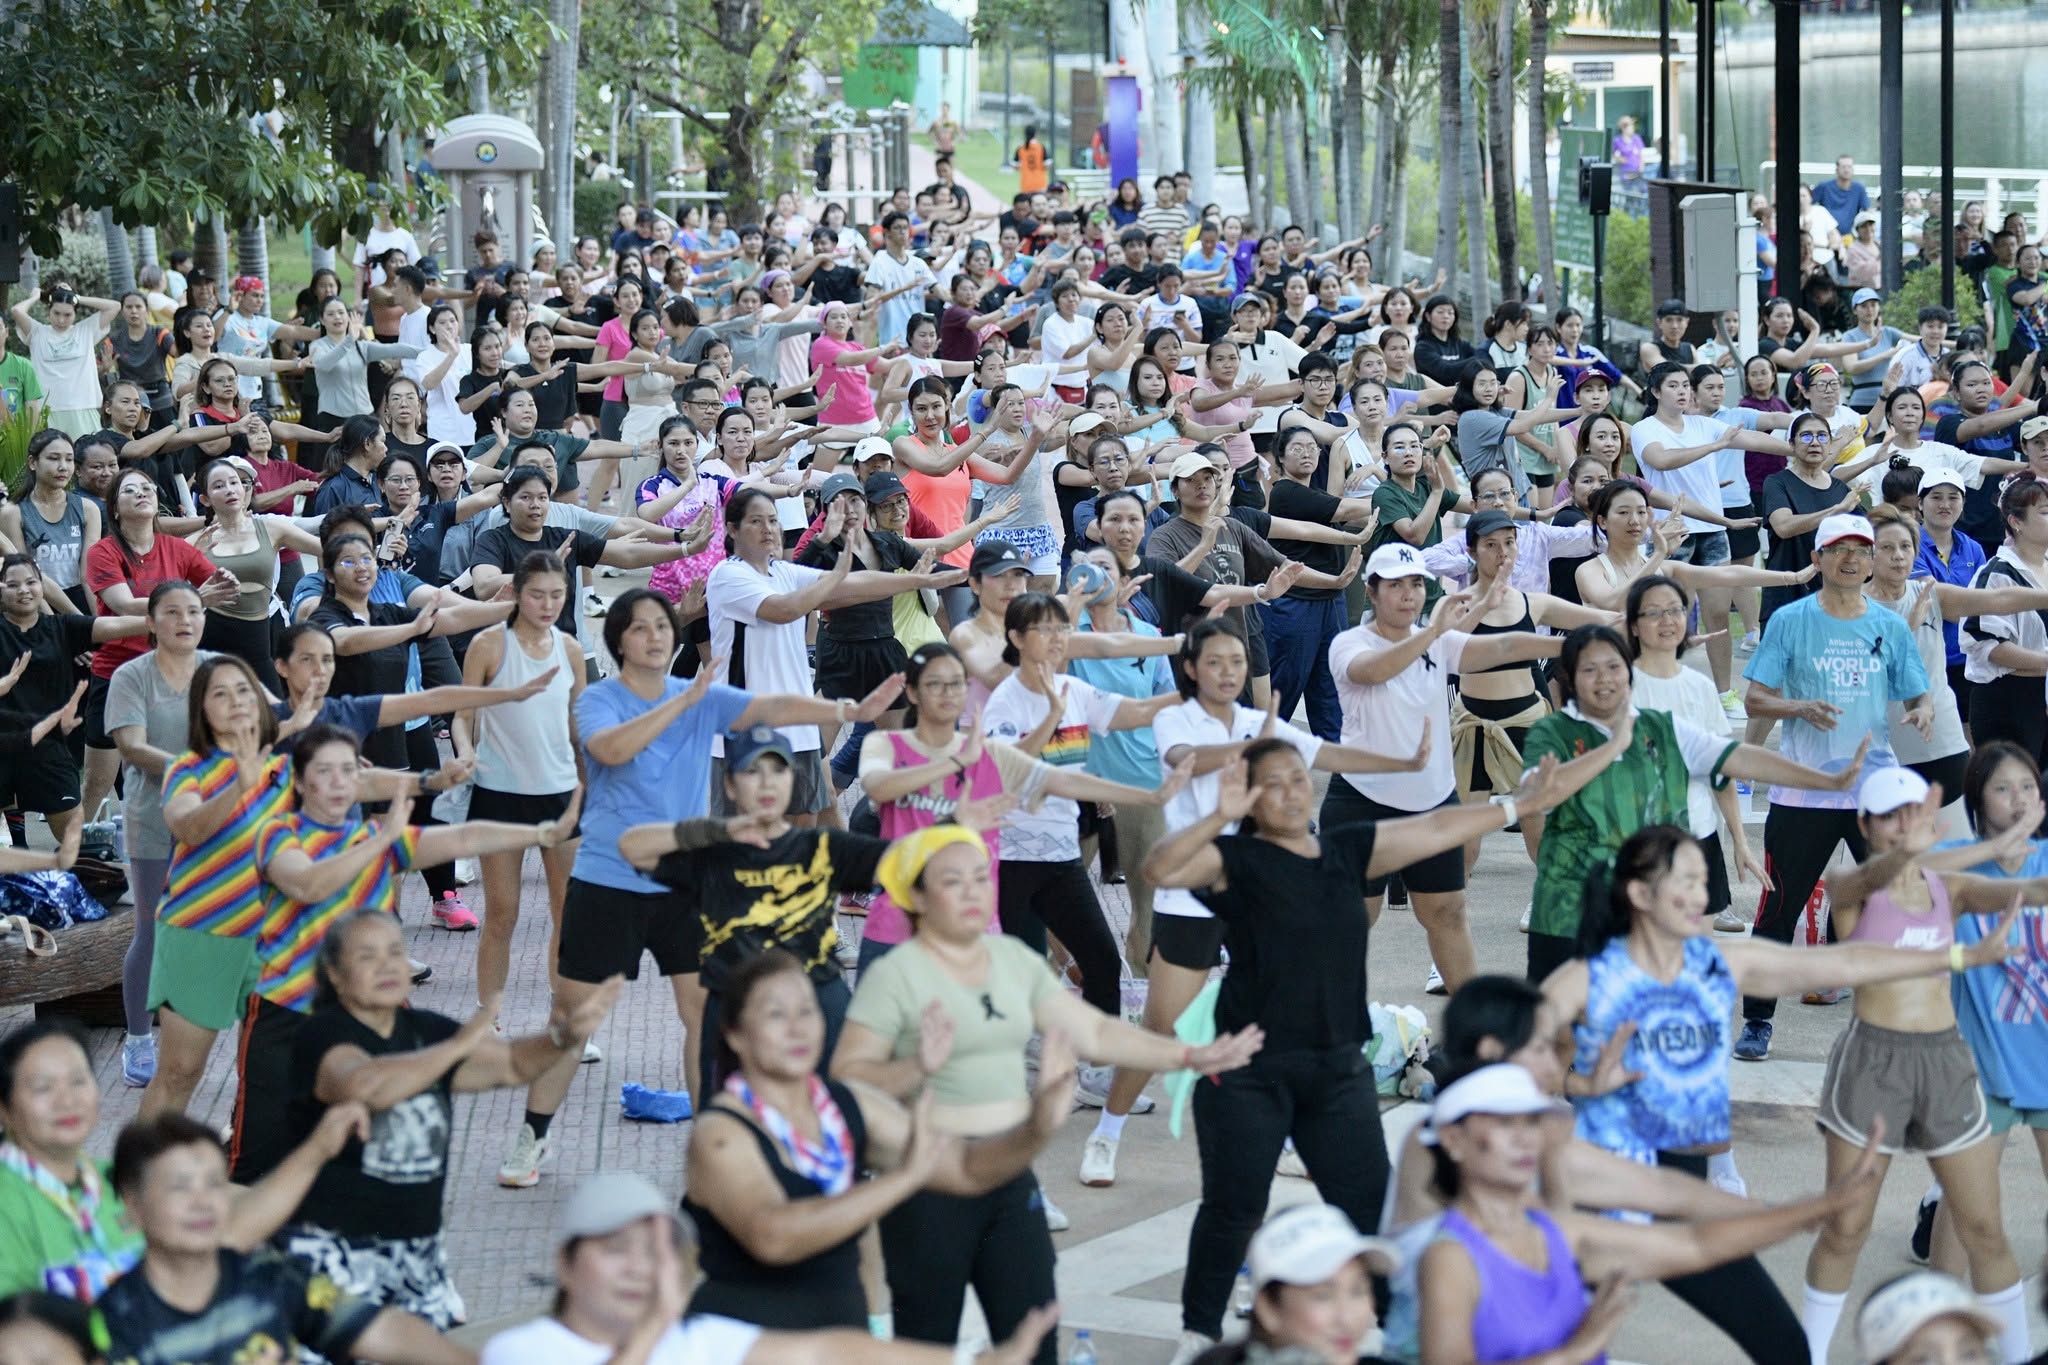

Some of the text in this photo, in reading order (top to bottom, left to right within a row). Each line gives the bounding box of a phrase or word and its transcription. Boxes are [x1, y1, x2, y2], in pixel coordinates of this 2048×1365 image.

[35, 543, 80, 562] PMT
[1823, 648, 1871, 656] AYUDHYA
[1812, 657, 1881, 673] WORLD
[1830, 671, 1867, 687] RUN
[1902, 926, 1939, 948] NIKE
[1632, 1020, 1724, 1054] AWESOME
